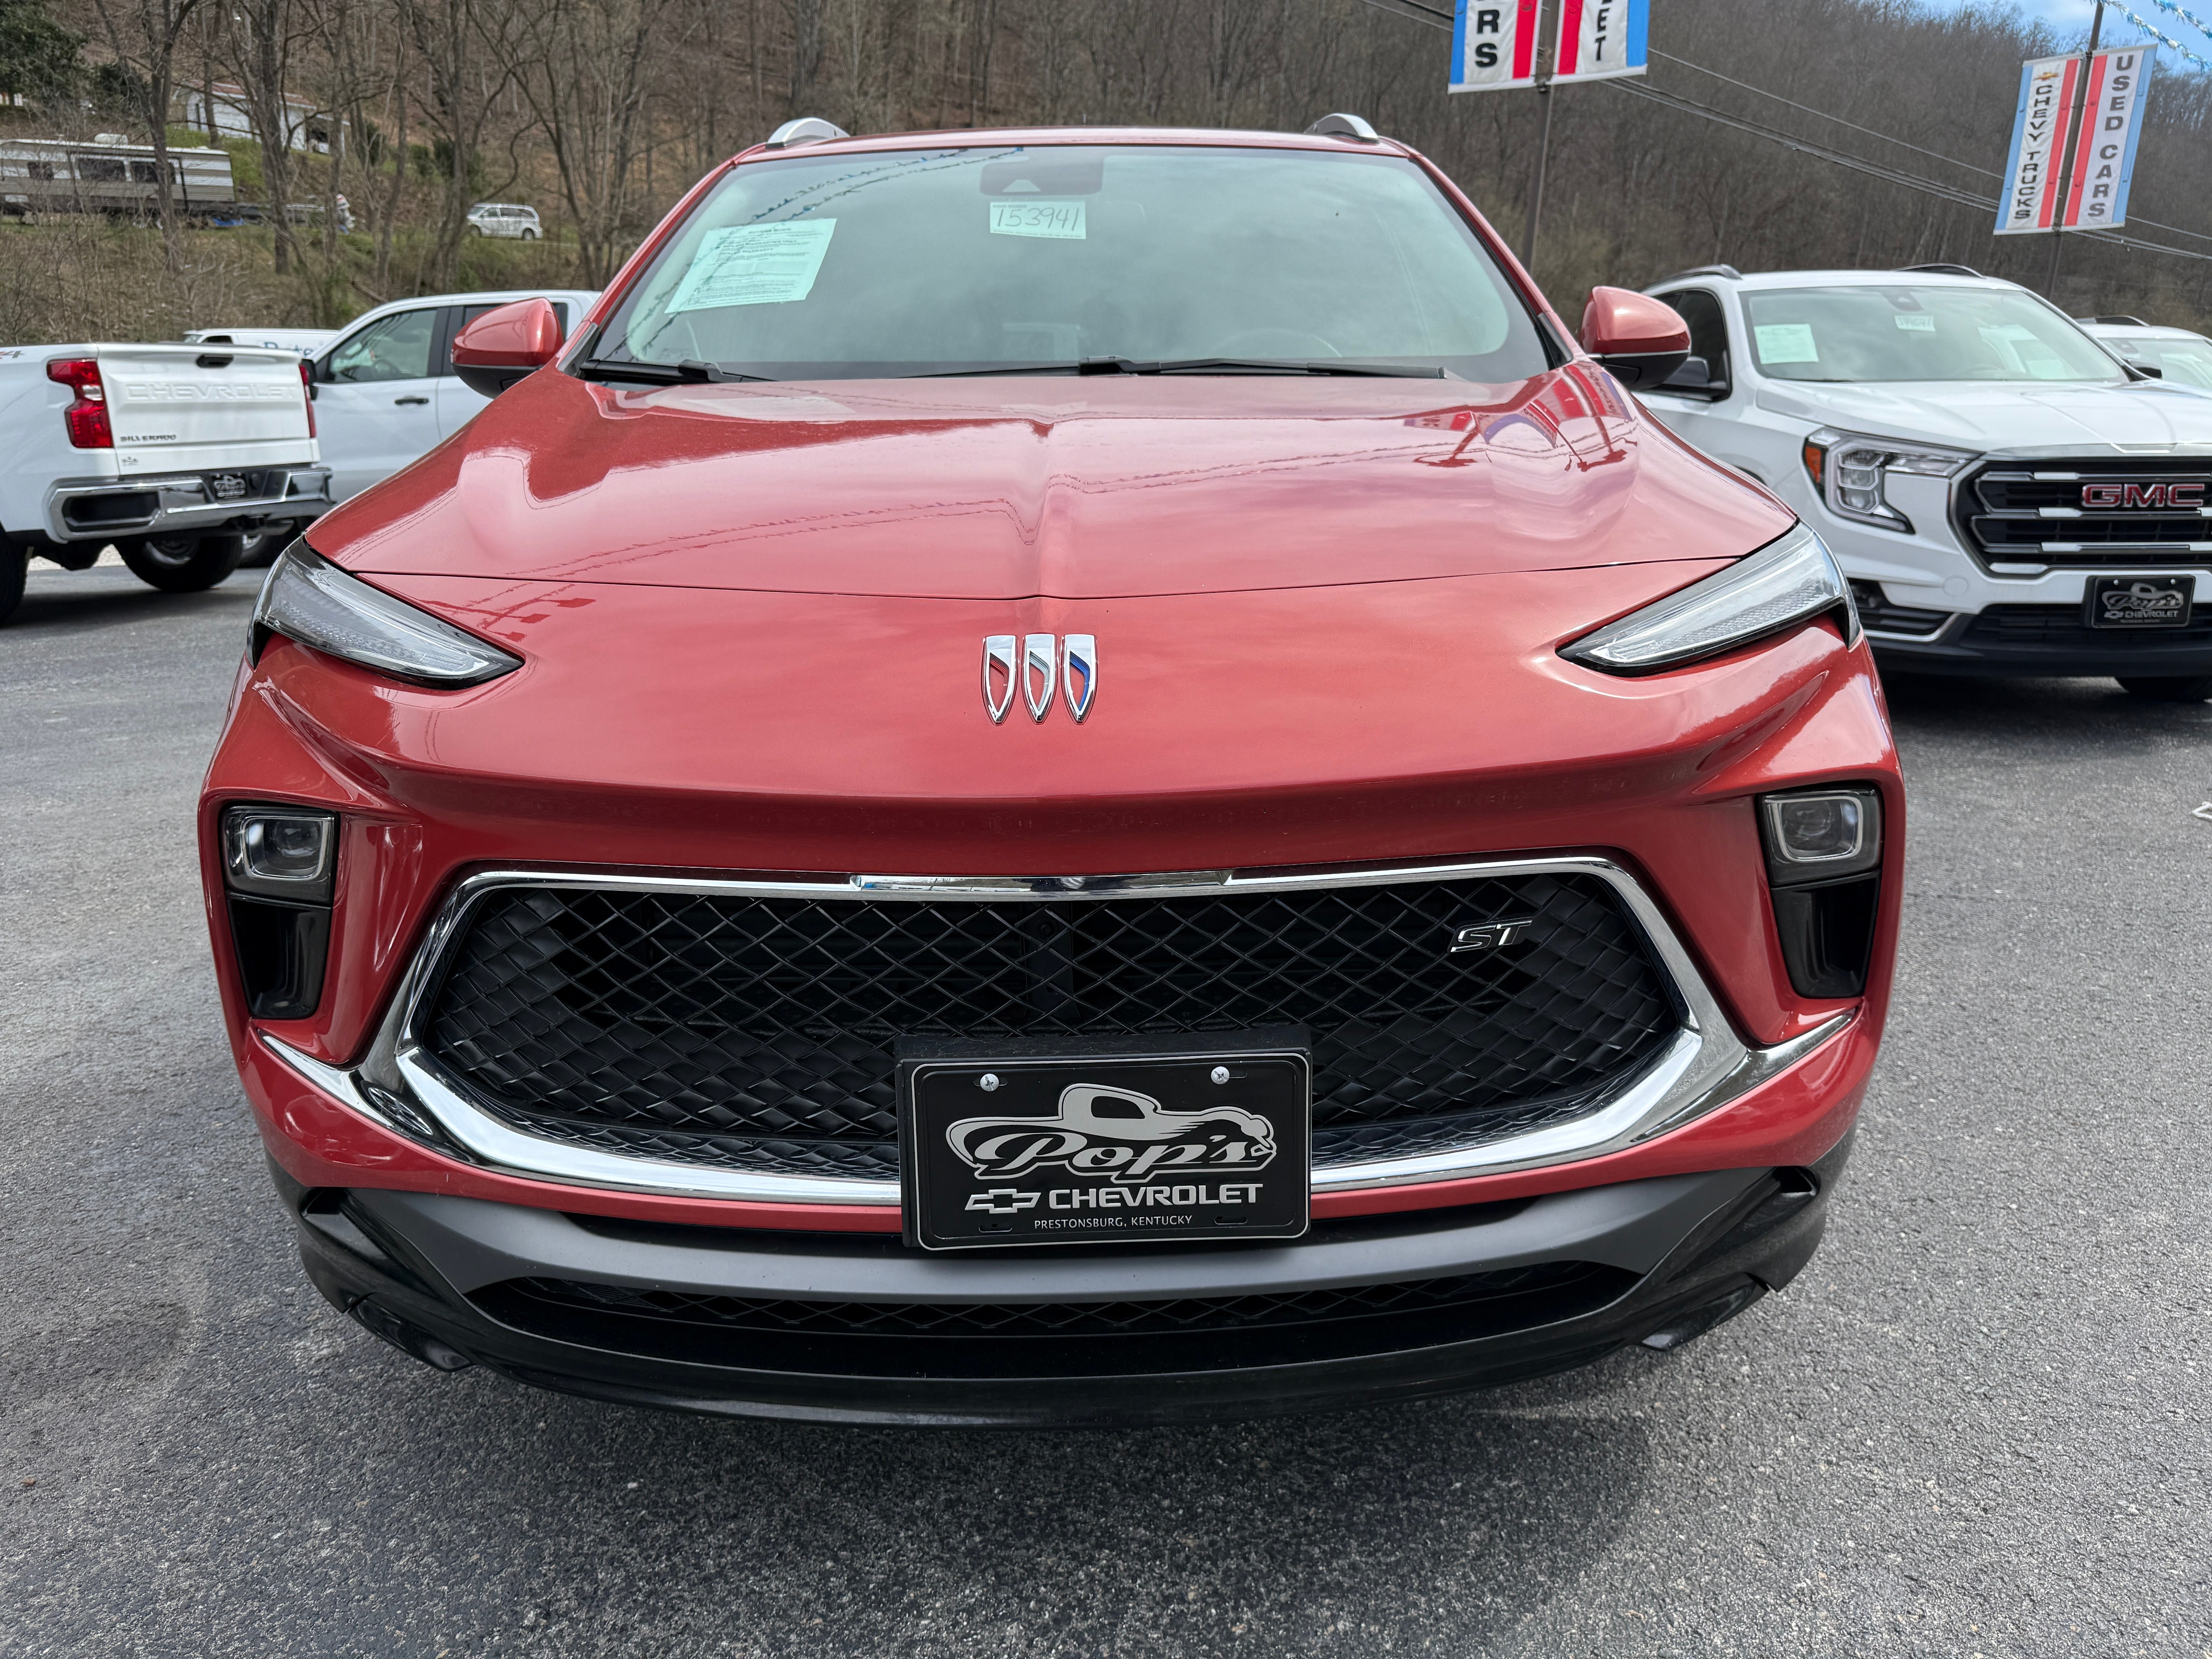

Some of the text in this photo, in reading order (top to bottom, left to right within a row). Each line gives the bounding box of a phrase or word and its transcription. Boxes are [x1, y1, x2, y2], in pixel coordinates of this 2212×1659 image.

[1475, 0, 1500, 68] RS
[1595, 0, 1612, 61] ET
[2014, 85, 2053, 219] CHEVY TRUCKS
[2088, 55, 2134, 217] USED CARS
[998, 207, 1079, 231] 153941
[126, 383, 294, 400] CHEVROLET
[2082, 483, 2205, 507] GMC
[1450, 919, 1532, 952] ST
[974, 1132, 1257, 1174] Pop's
[1049, 1183, 1263, 1209] CHEVROLET
[1034, 1215, 1192, 1229] PRESTONSBURG, KENTUCKY
